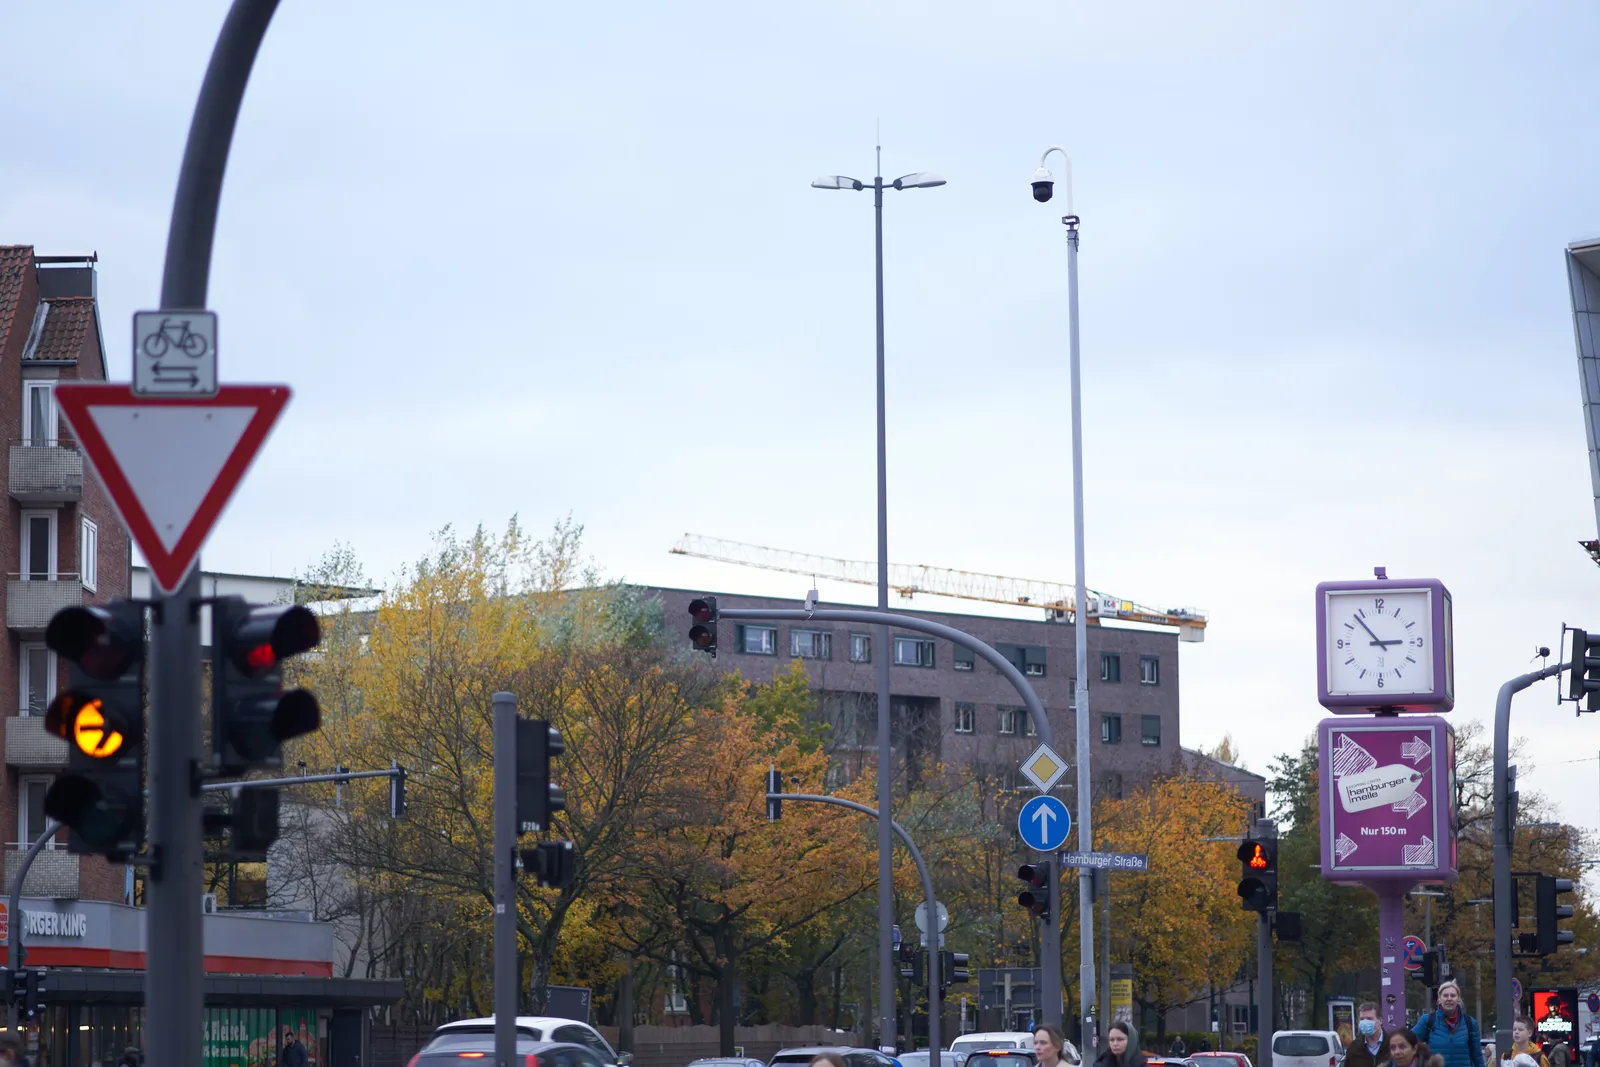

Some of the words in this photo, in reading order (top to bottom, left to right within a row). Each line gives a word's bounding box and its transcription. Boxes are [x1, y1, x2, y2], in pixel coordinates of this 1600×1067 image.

[1375, 598, 1384, 609] 12
[1337, 639, 1344, 649] 9
[1417, 637, 1423, 647] 3
[1377, 678, 1384, 688] 6
[1349, 777, 1407, 797] hamburger
[1351, 791, 1378, 803] meile
[1360, 826, 1378, 835] Nur
[1380, 826, 1396, 835] 150
[1063, 853, 1111, 868] Hamburger
[1114, 855, 1142, 868] Straße
[28, 911, 58, 936] RGER
[60, 912, 87, 937] KING
